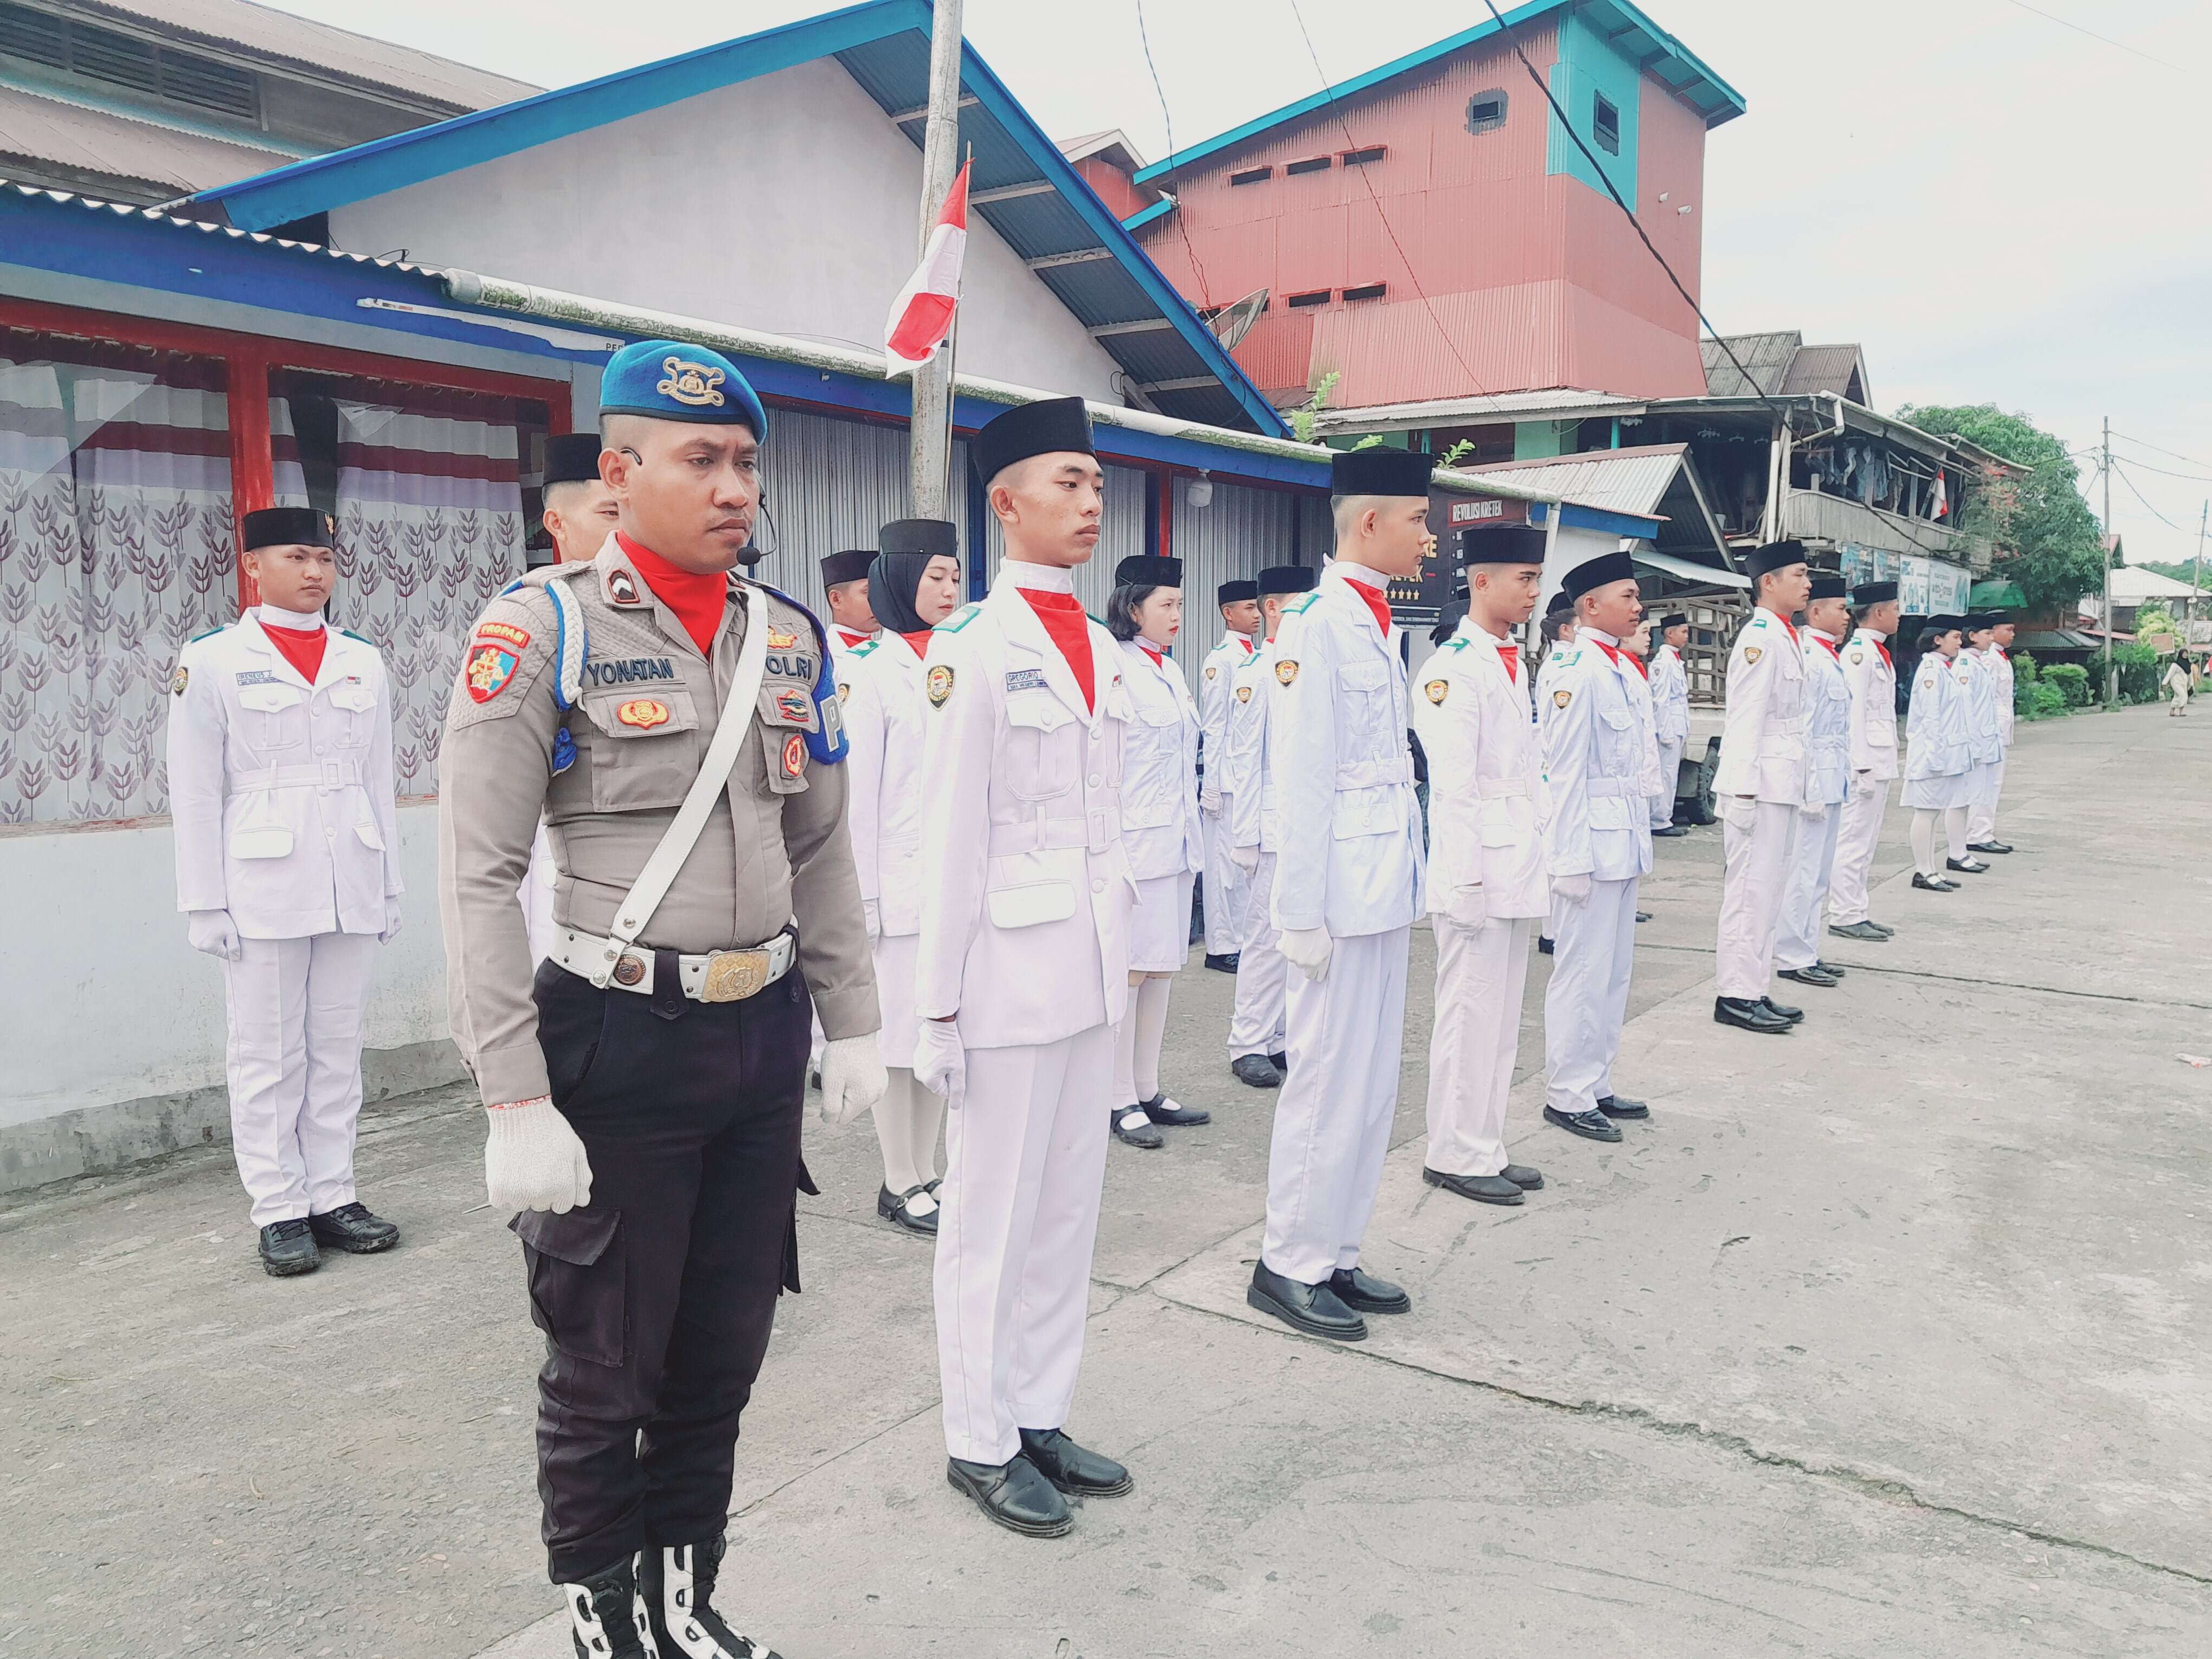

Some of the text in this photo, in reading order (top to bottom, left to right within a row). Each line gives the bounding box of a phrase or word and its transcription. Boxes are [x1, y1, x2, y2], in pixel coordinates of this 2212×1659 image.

[1452, 500, 1503, 522] REVOLUSI KRETEK
[481, 625, 525, 643] PROPAM
[239, 672, 265, 680] IRENEUS
[587, 658, 674, 686] YONATAN
[766, 655, 812, 680] OLRI
[1008, 672, 1038, 682] GREGORIO
